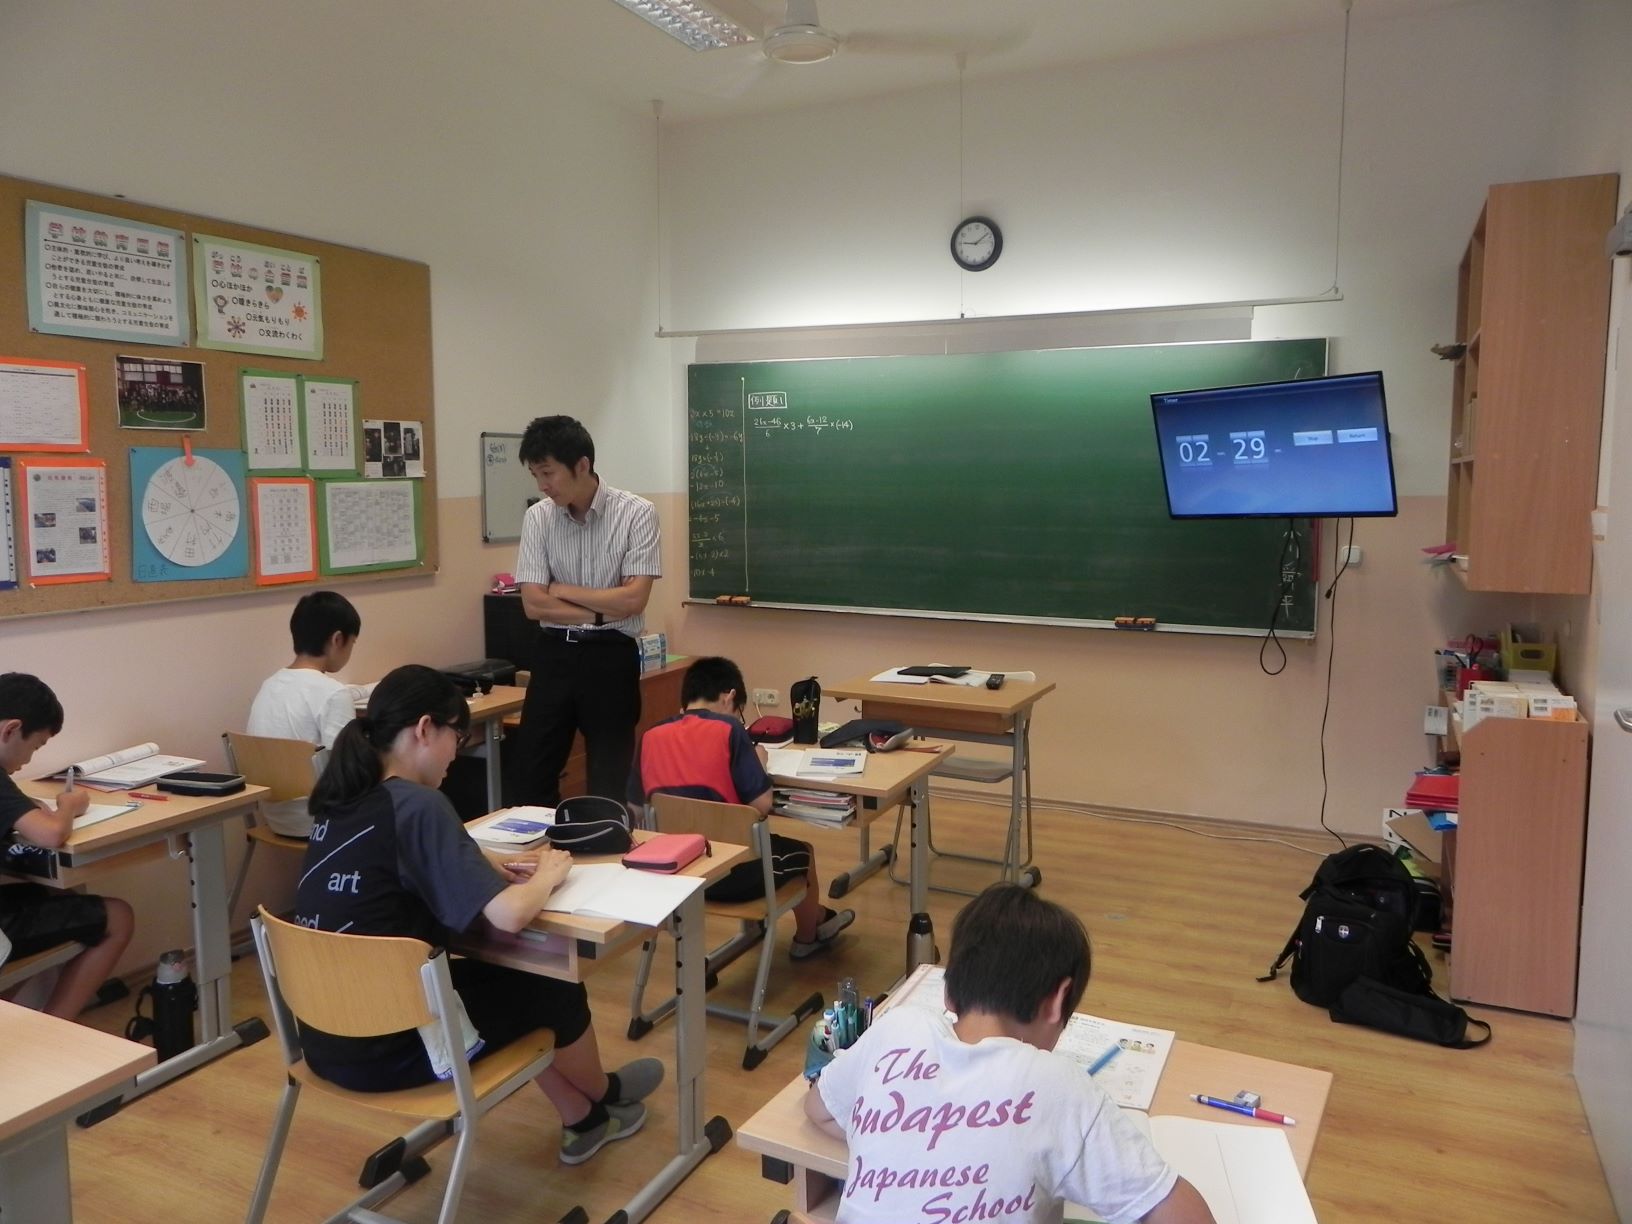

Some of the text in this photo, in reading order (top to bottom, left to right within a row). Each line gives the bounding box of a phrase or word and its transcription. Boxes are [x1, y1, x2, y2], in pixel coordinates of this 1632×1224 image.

[1179, 437, 1265, 463] 02 29
[327, 870, 362, 894] art
[874, 1047, 940, 1085] The
[851, 1090, 1035, 1151] Budapest
[847, 1155, 989, 1202] Japanese
[921, 1184, 1035, 1224] School
